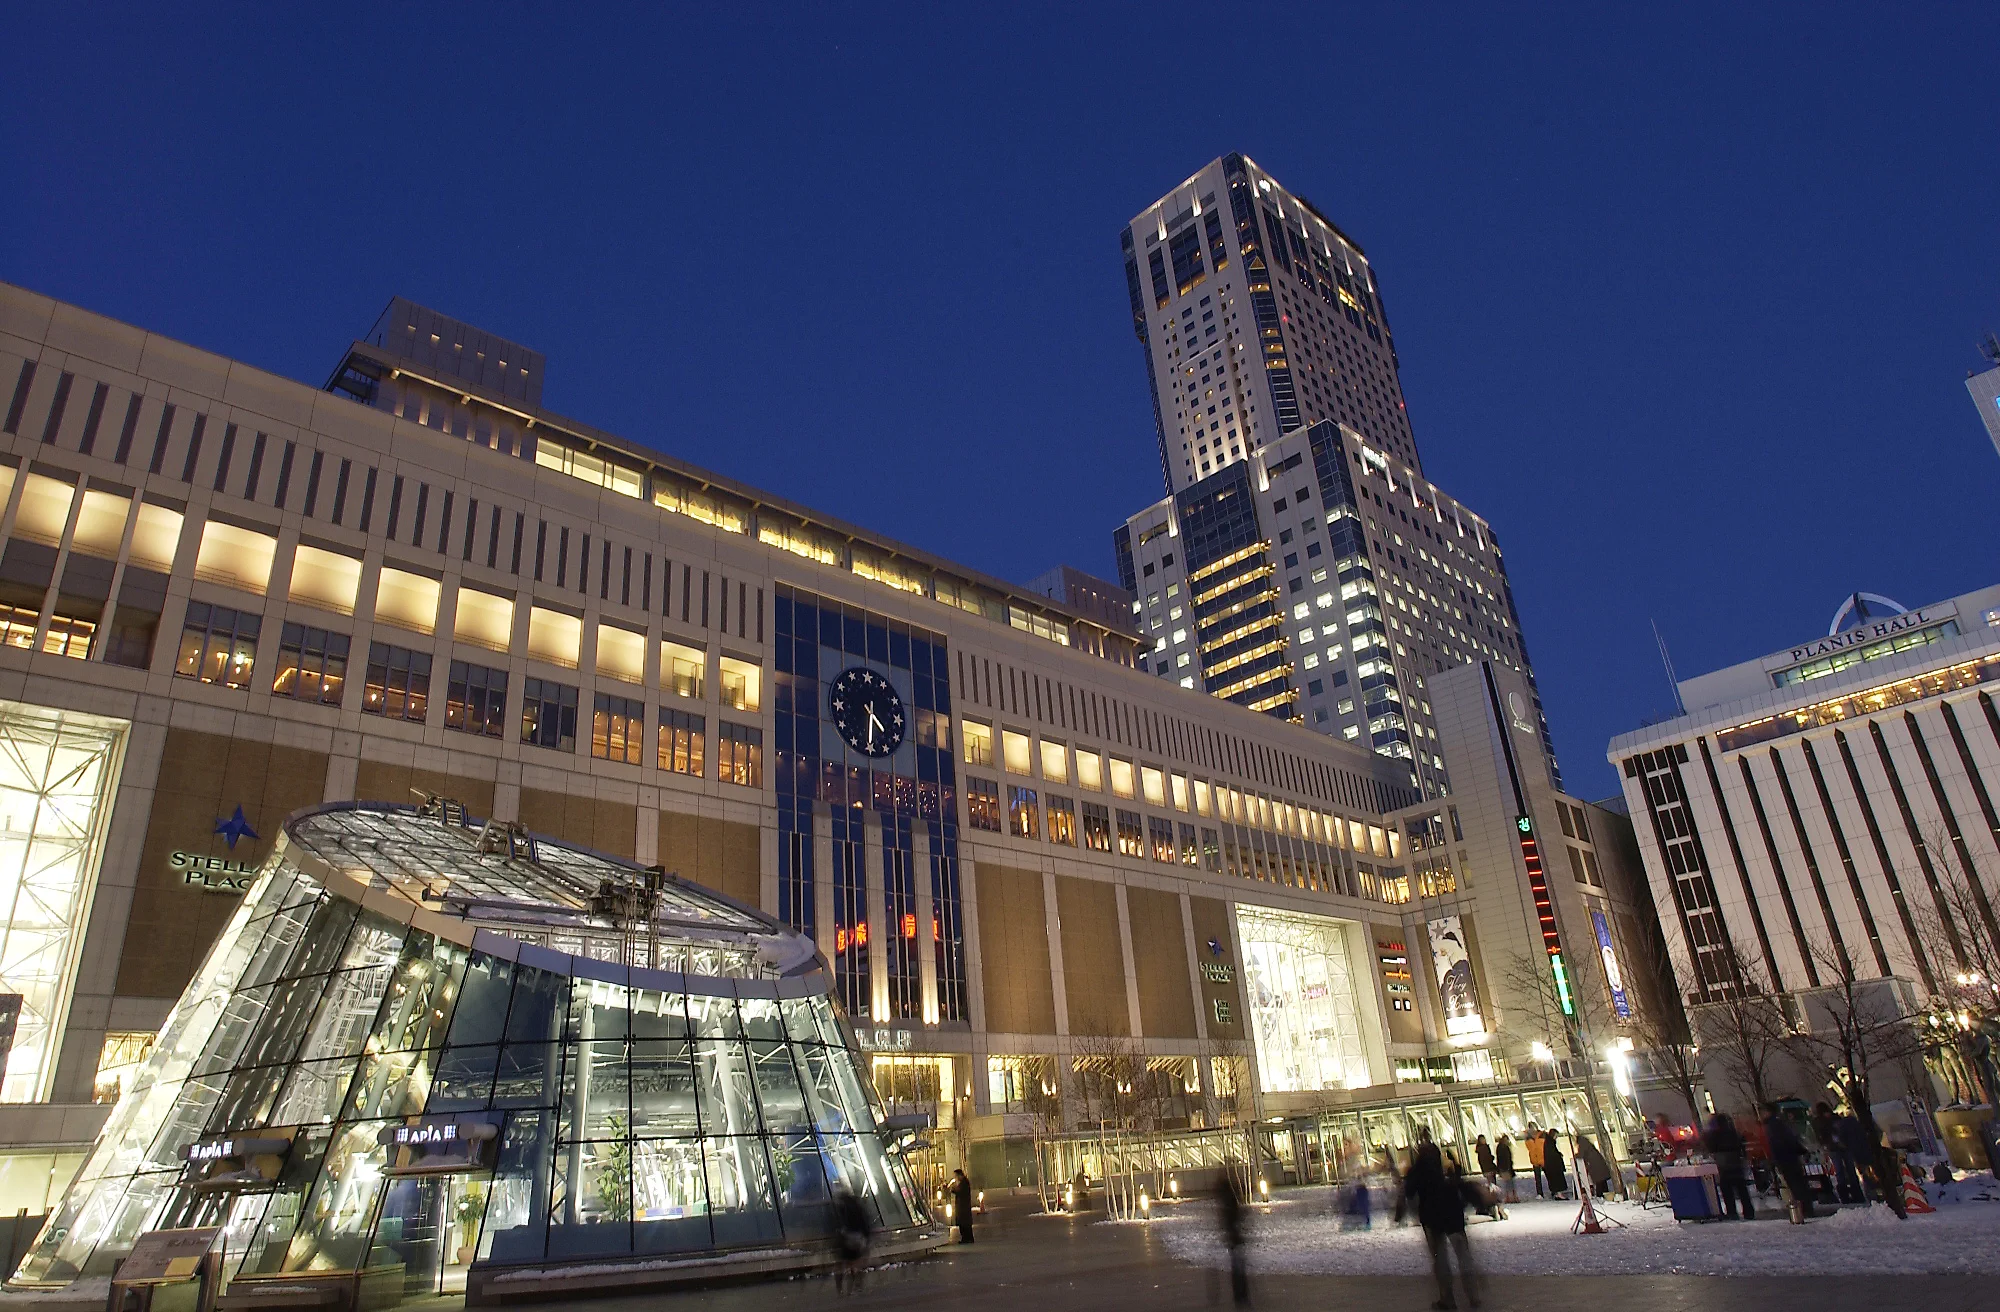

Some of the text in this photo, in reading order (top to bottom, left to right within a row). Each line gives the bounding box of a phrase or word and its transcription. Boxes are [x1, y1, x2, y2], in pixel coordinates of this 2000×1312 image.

[1791, 612, 1930, 661] PLANIS HALL
[171, 851, 259, 874] STELL
[1445, 973, 1467, 992] Very
